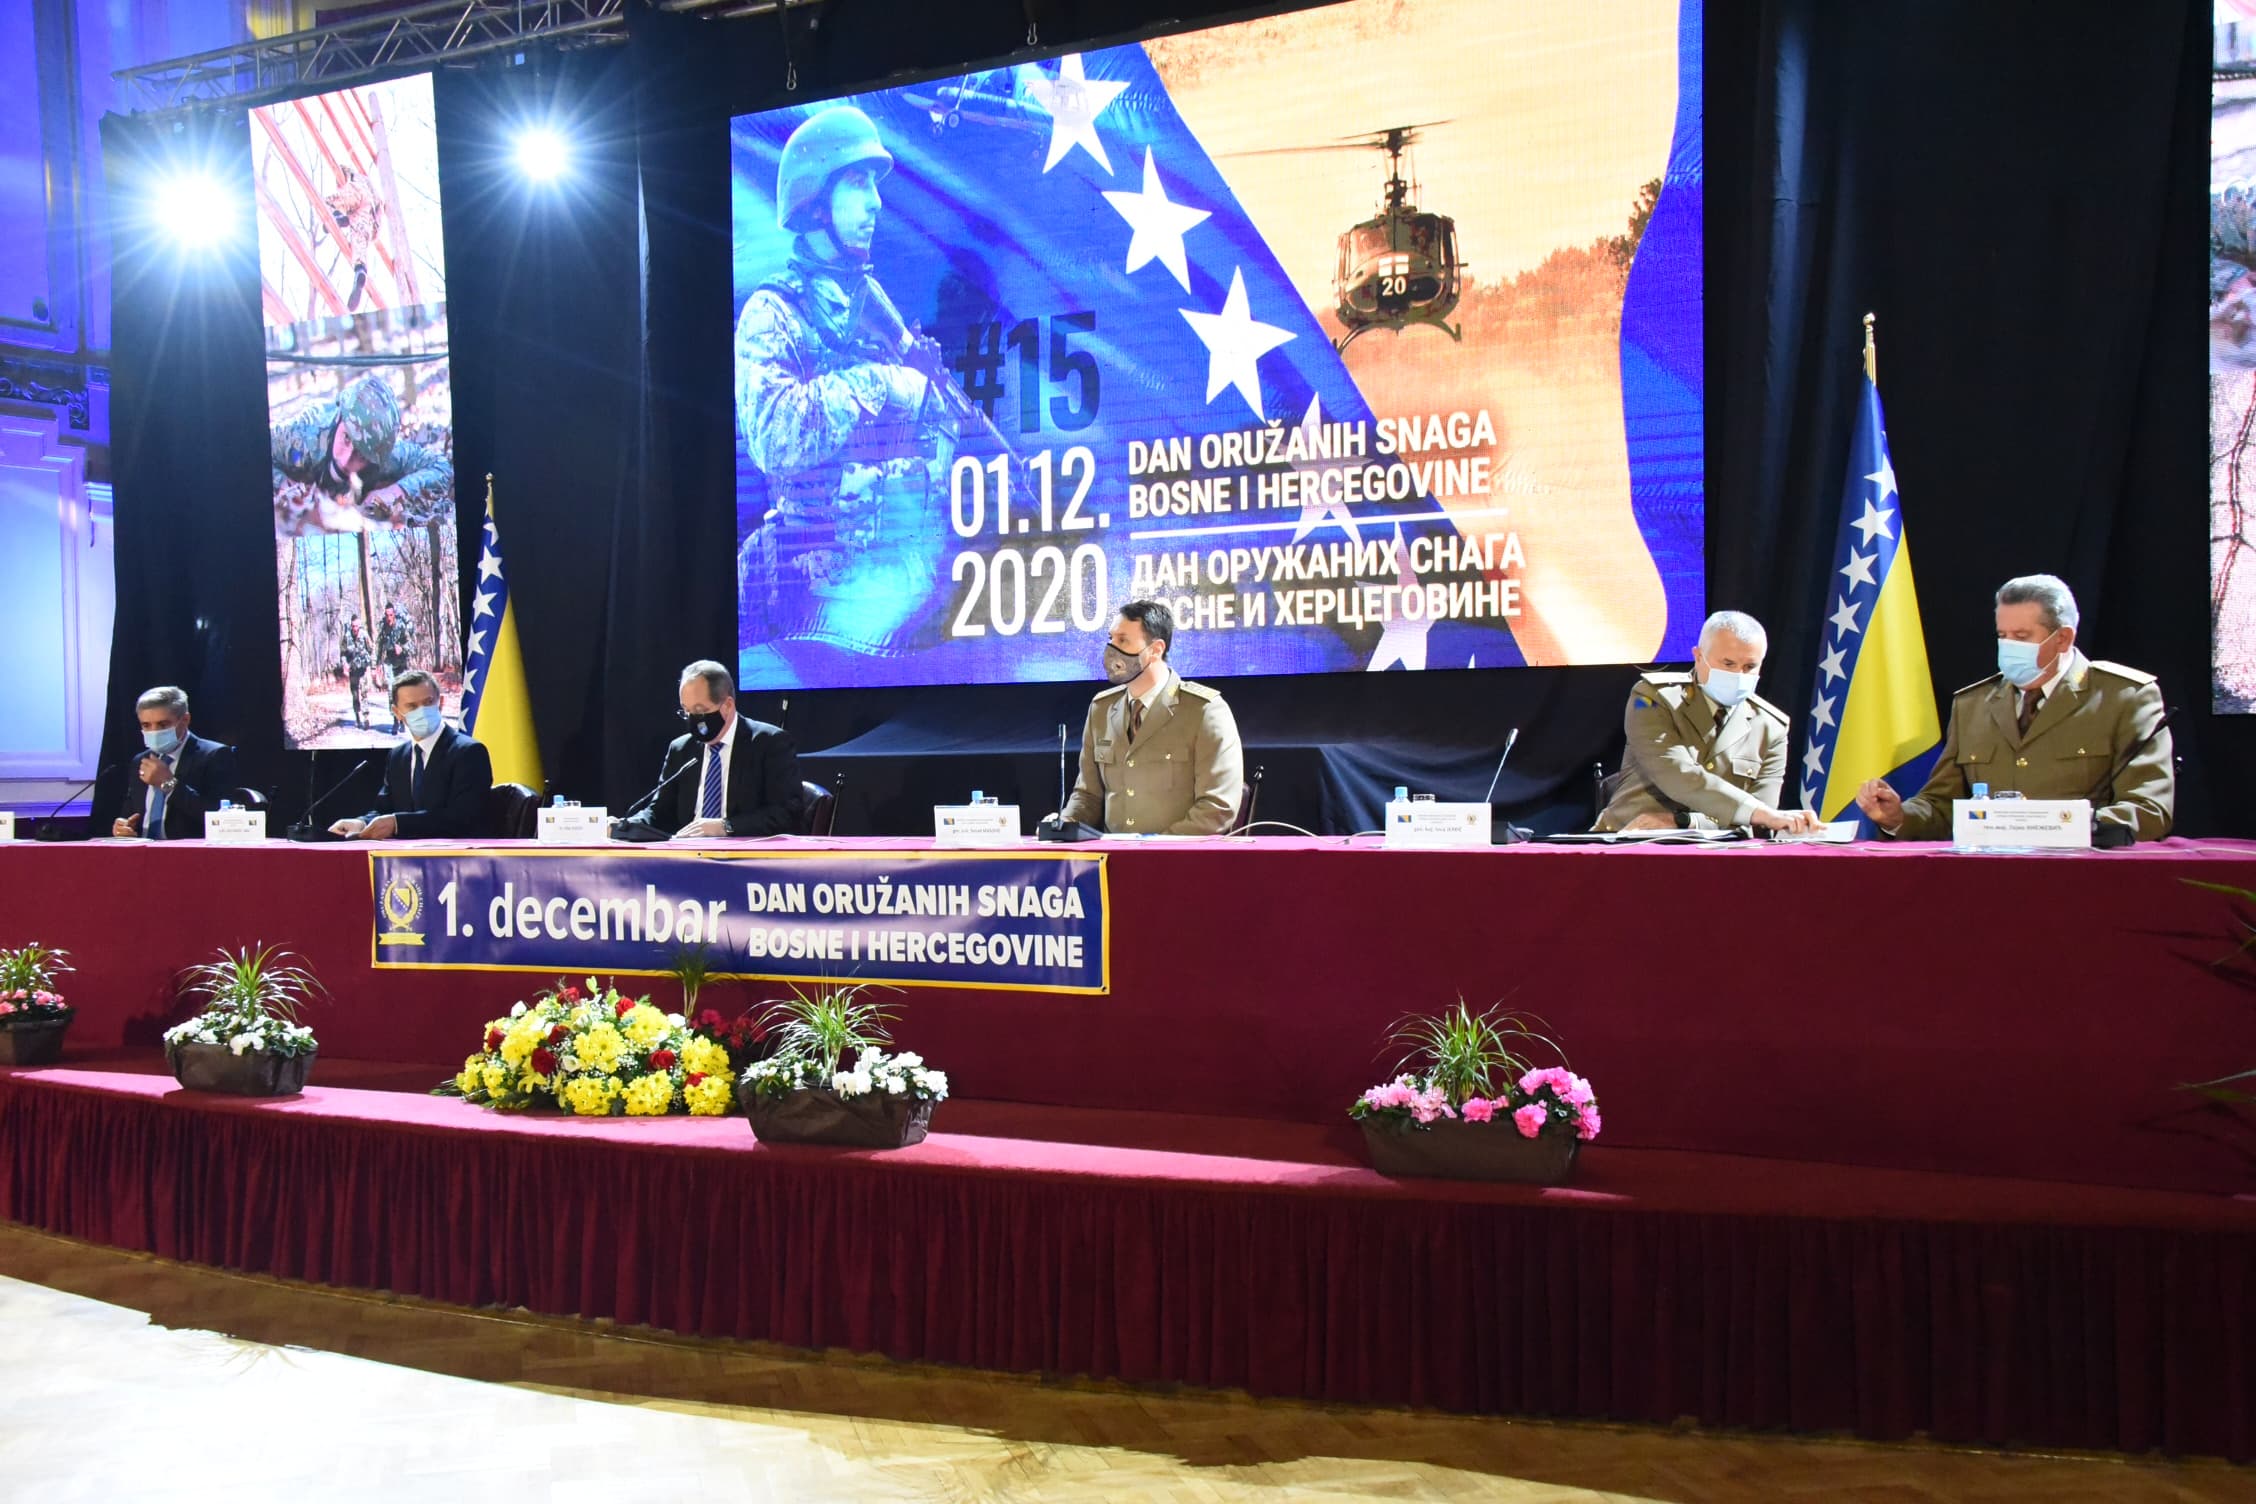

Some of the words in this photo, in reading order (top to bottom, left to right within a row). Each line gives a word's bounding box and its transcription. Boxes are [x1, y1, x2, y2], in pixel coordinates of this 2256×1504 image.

[1382, 276, 1407, 296] 20
[956, 311, 1100, 433] #15
[1128, 436, 1192, 475] DAN
[1199, 419, 1367, 469] ORUŽANIH
[1375, 410, 1498, 455] SNAGA
[951, 446, 1110, 538] 01.12.
[1129, 477, 1232, 518] BOSNE
[1239, 475, 1249, 511] I
[1257, 457, 1492, 509] HERCEGOVINE
[952, 543, 1108, 637] 2020
[1130, 551, 1200, 596] ДАН
[1207, 540, 1402, 584] ОРУЖАНИХ
[1410, 532, 1526, 573] СНАГА
[1133, 593, 1236, 630] СНЕ
[1243, 592, 1267, 627] И
[1273, 579, 1522, 630] ХЕРЦЕГОВИНЕ
[438, 882, 474, 937] 1.
[488, 882, 727, 944] decembar
[747, 883, 807, 913] DAN
[813, 876, 969, 916] ORUŽANIH
[977, 885, 1085, 918] SNAGA
[750, 927, 844, 960] BOSNE
[851, 930, 860, 961] I
[867, 931, 1084, 968] HERCEGOVINE
